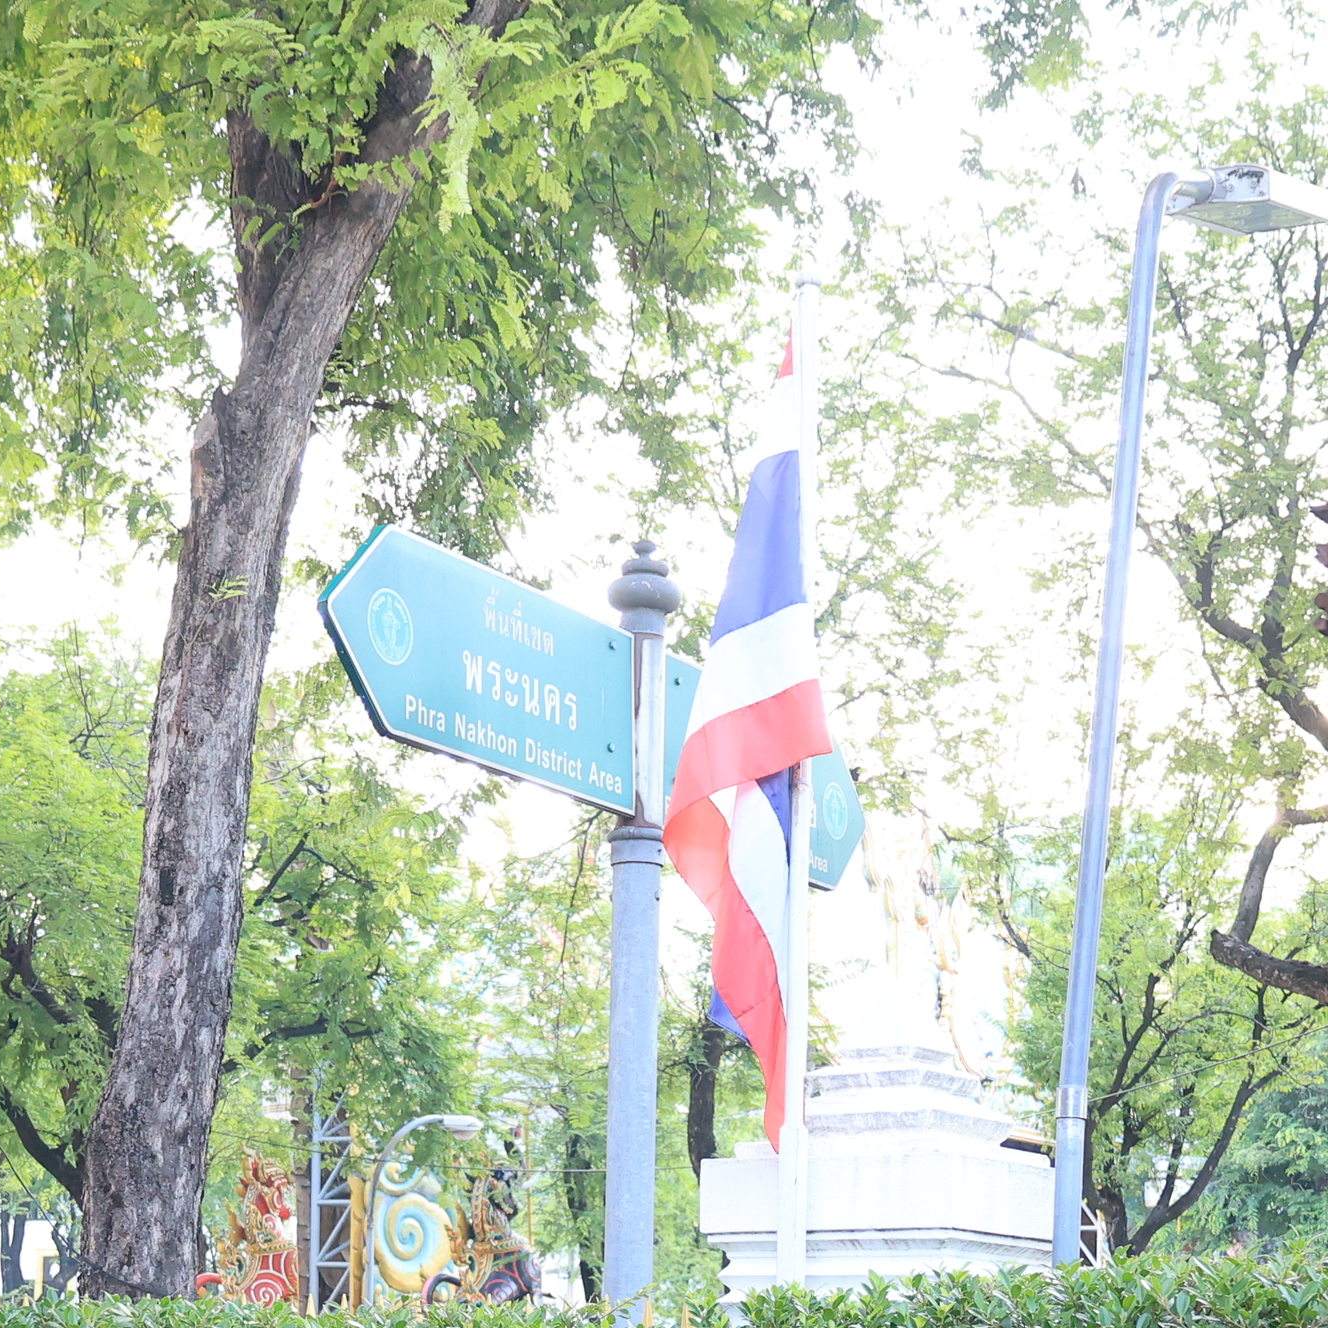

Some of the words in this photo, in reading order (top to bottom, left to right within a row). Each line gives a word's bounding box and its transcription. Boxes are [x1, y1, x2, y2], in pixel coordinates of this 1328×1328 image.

[483, 586, 554, 657] พื้นที่เขต
[462, 650, 578, 731] พระนคร
[405, 693, 447, 733] Phra
[454, 711, 518, 758] Nakhon
[525, 737, 583, 781] District
[588, 761, 623, 795] Area
